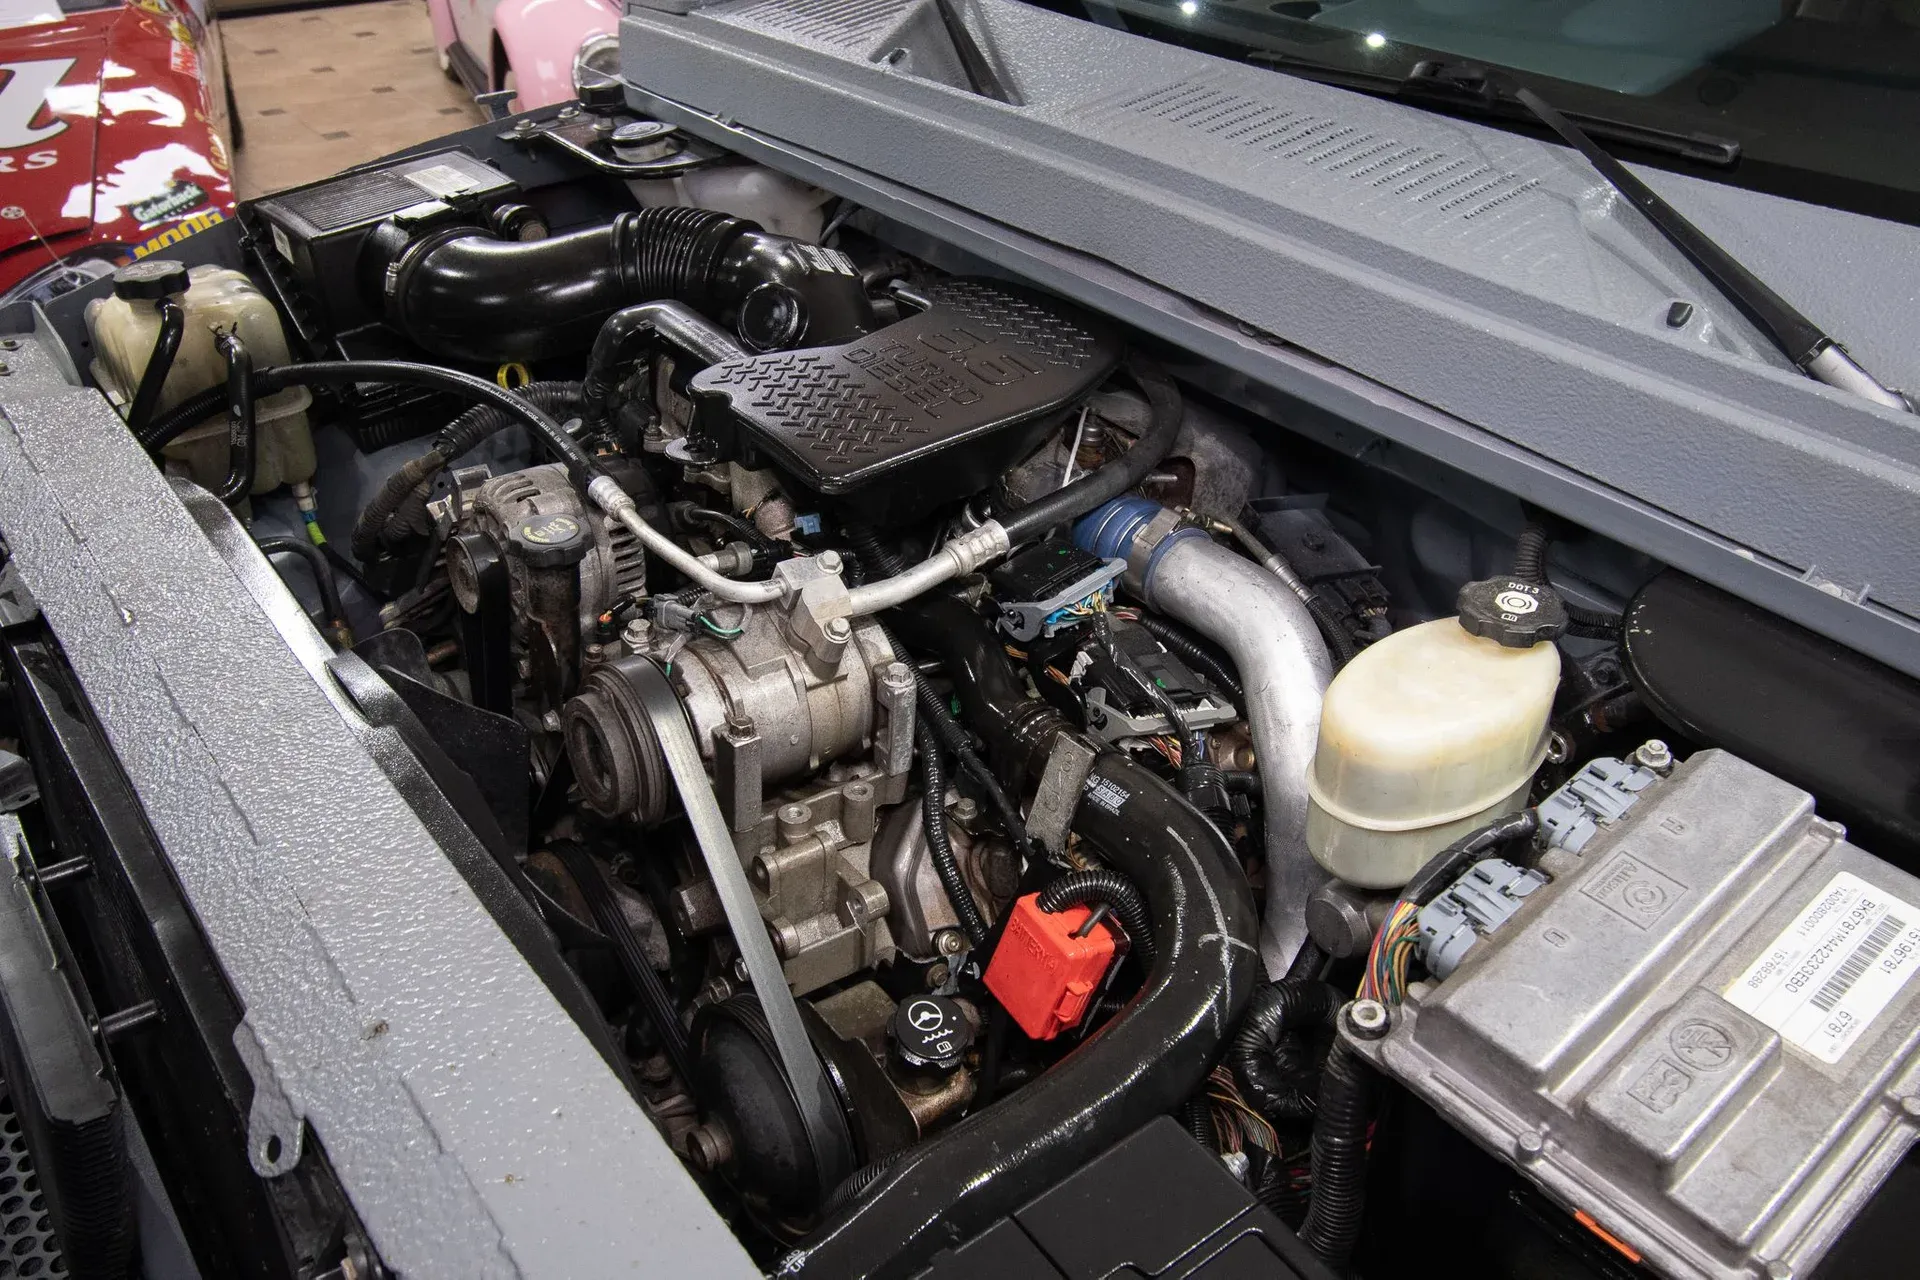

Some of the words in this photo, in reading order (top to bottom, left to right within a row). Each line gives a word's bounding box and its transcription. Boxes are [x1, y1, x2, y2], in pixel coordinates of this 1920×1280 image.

[842, 348, 947, 419] DIESEL
[879, 338, 983, 405] TURBO
[1508, 582, 1531, 593] DOT
[1101, 778, 1130, 799] 15102154
[1823, 1009, 1853, 1039] 6781
